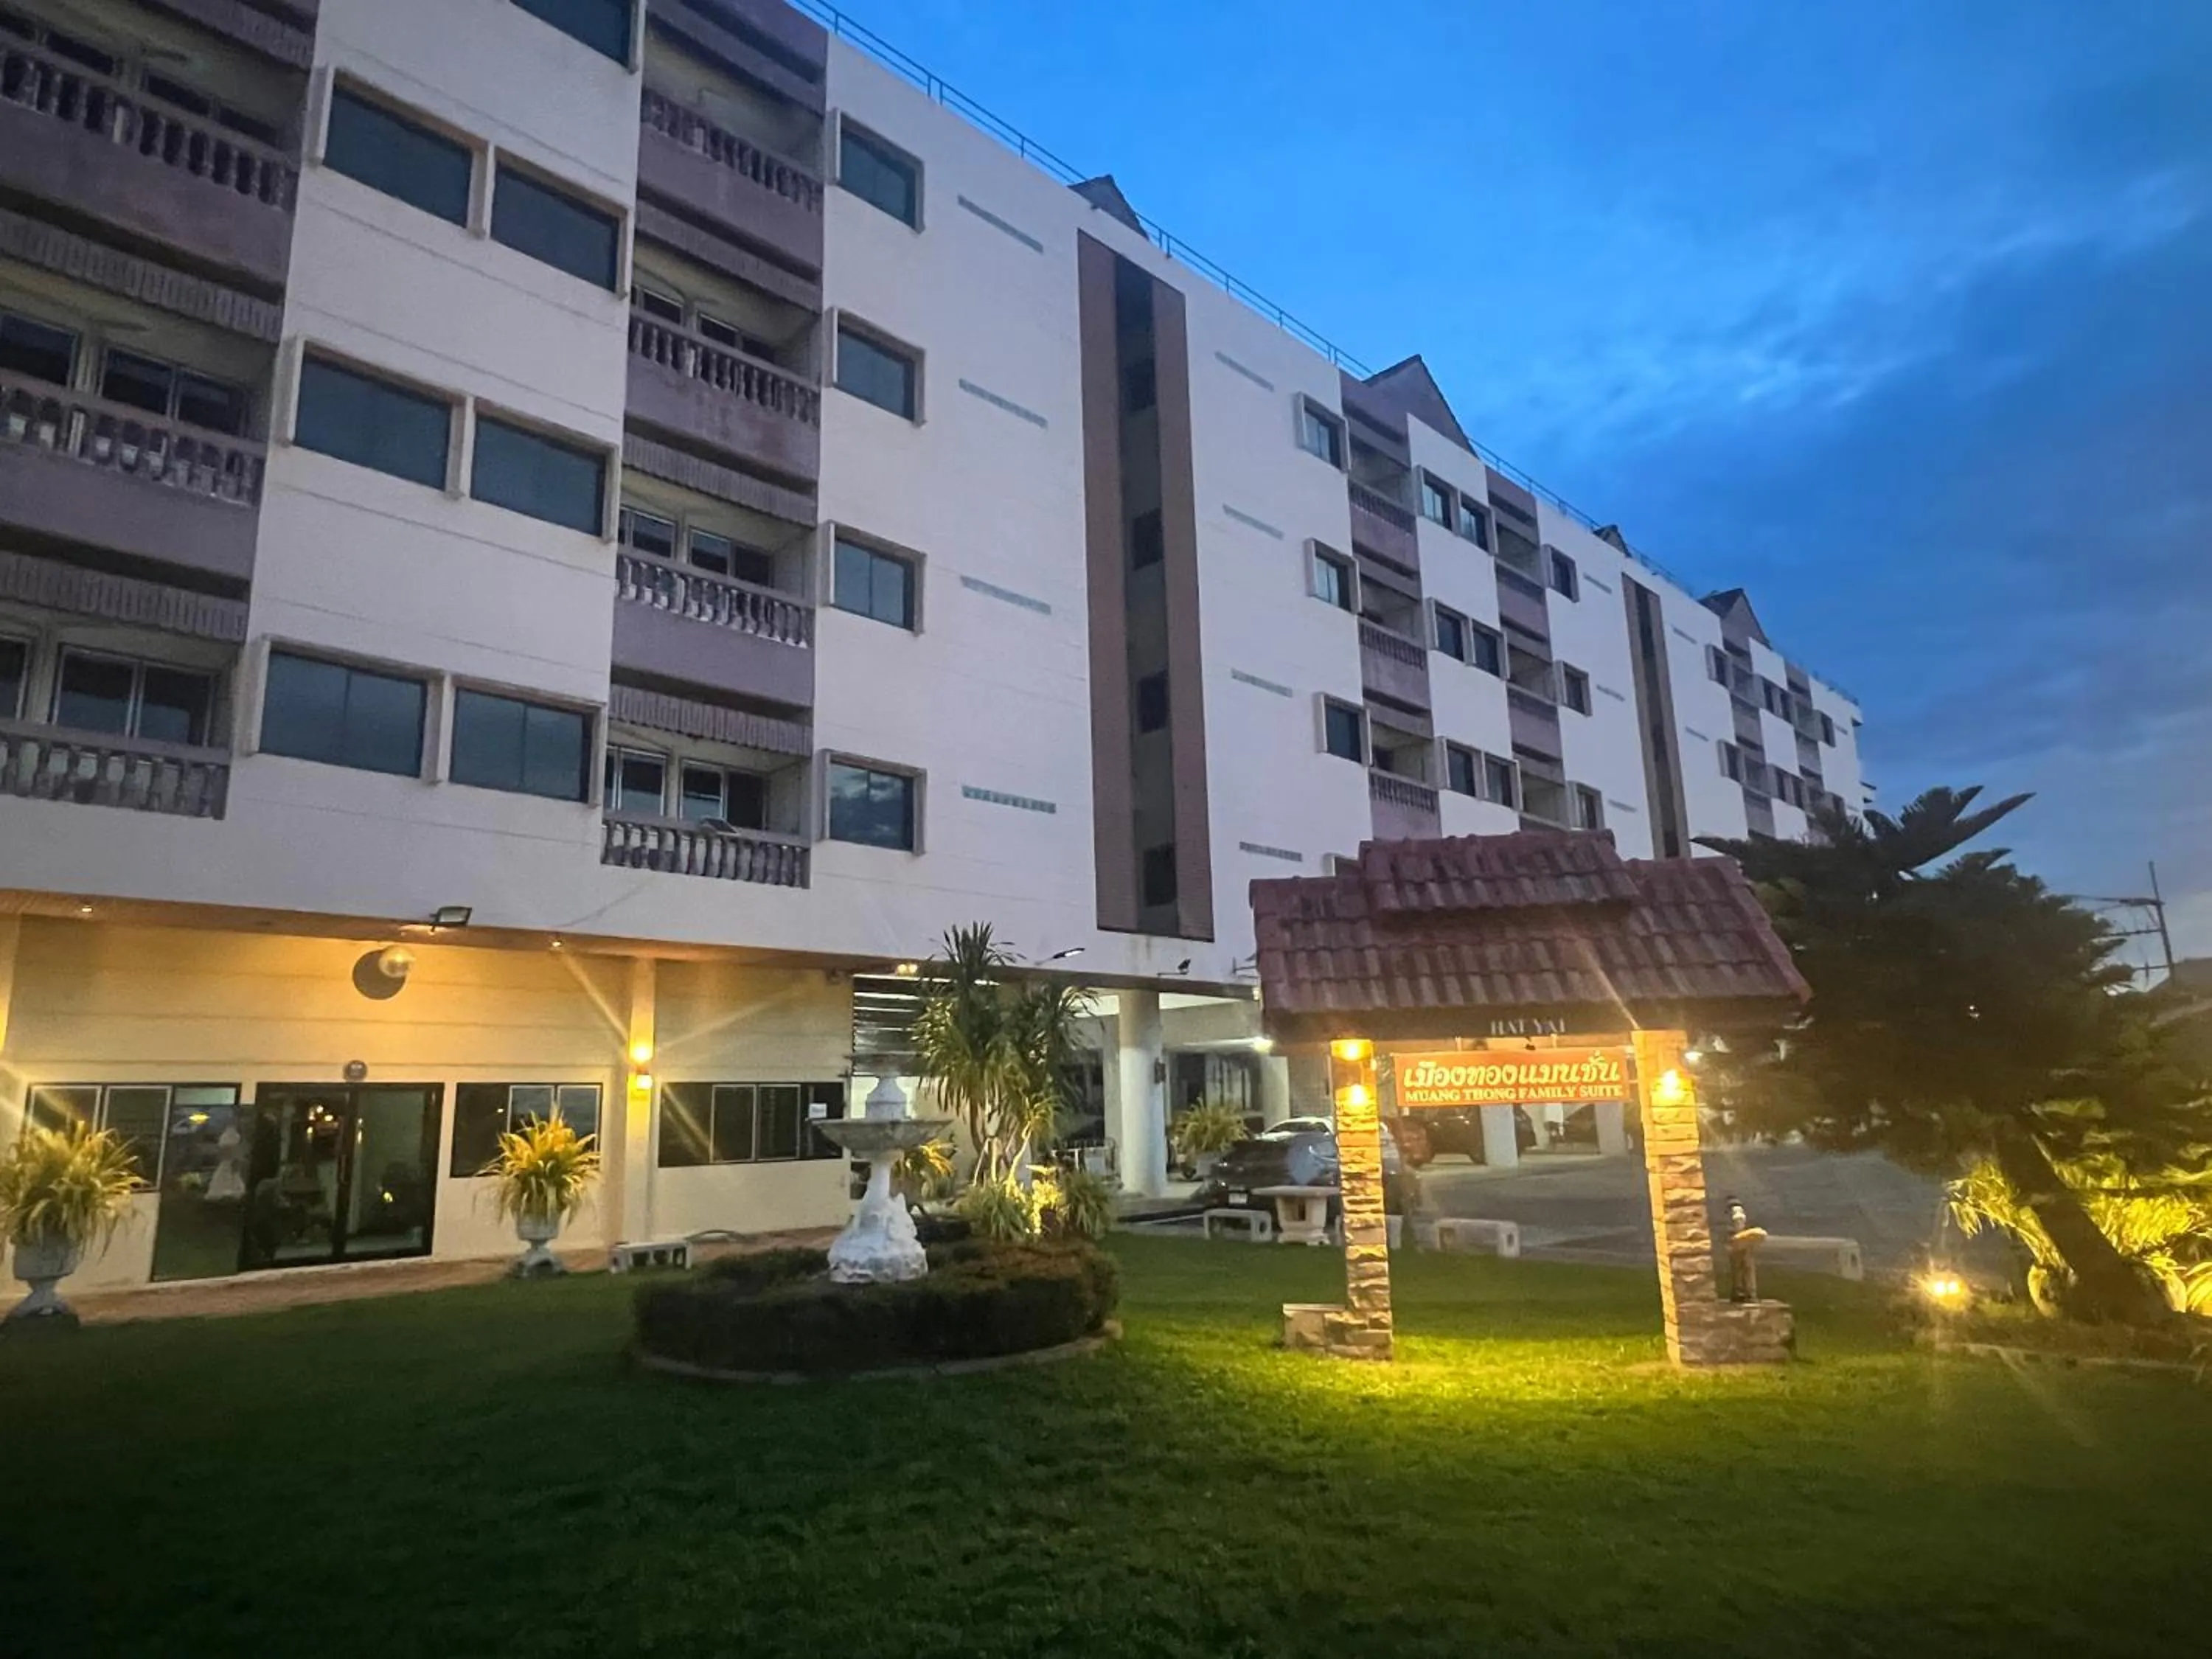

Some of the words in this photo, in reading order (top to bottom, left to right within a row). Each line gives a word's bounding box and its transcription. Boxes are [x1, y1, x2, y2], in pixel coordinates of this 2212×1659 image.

[1405, 1089, 1461, 1102] MUANG
[1462, 1087, 1517, 1101] THONG
[1517, 1085, 1577, 1099] FAMILY
[1579, 1084, 1624, 1099] SUITE
